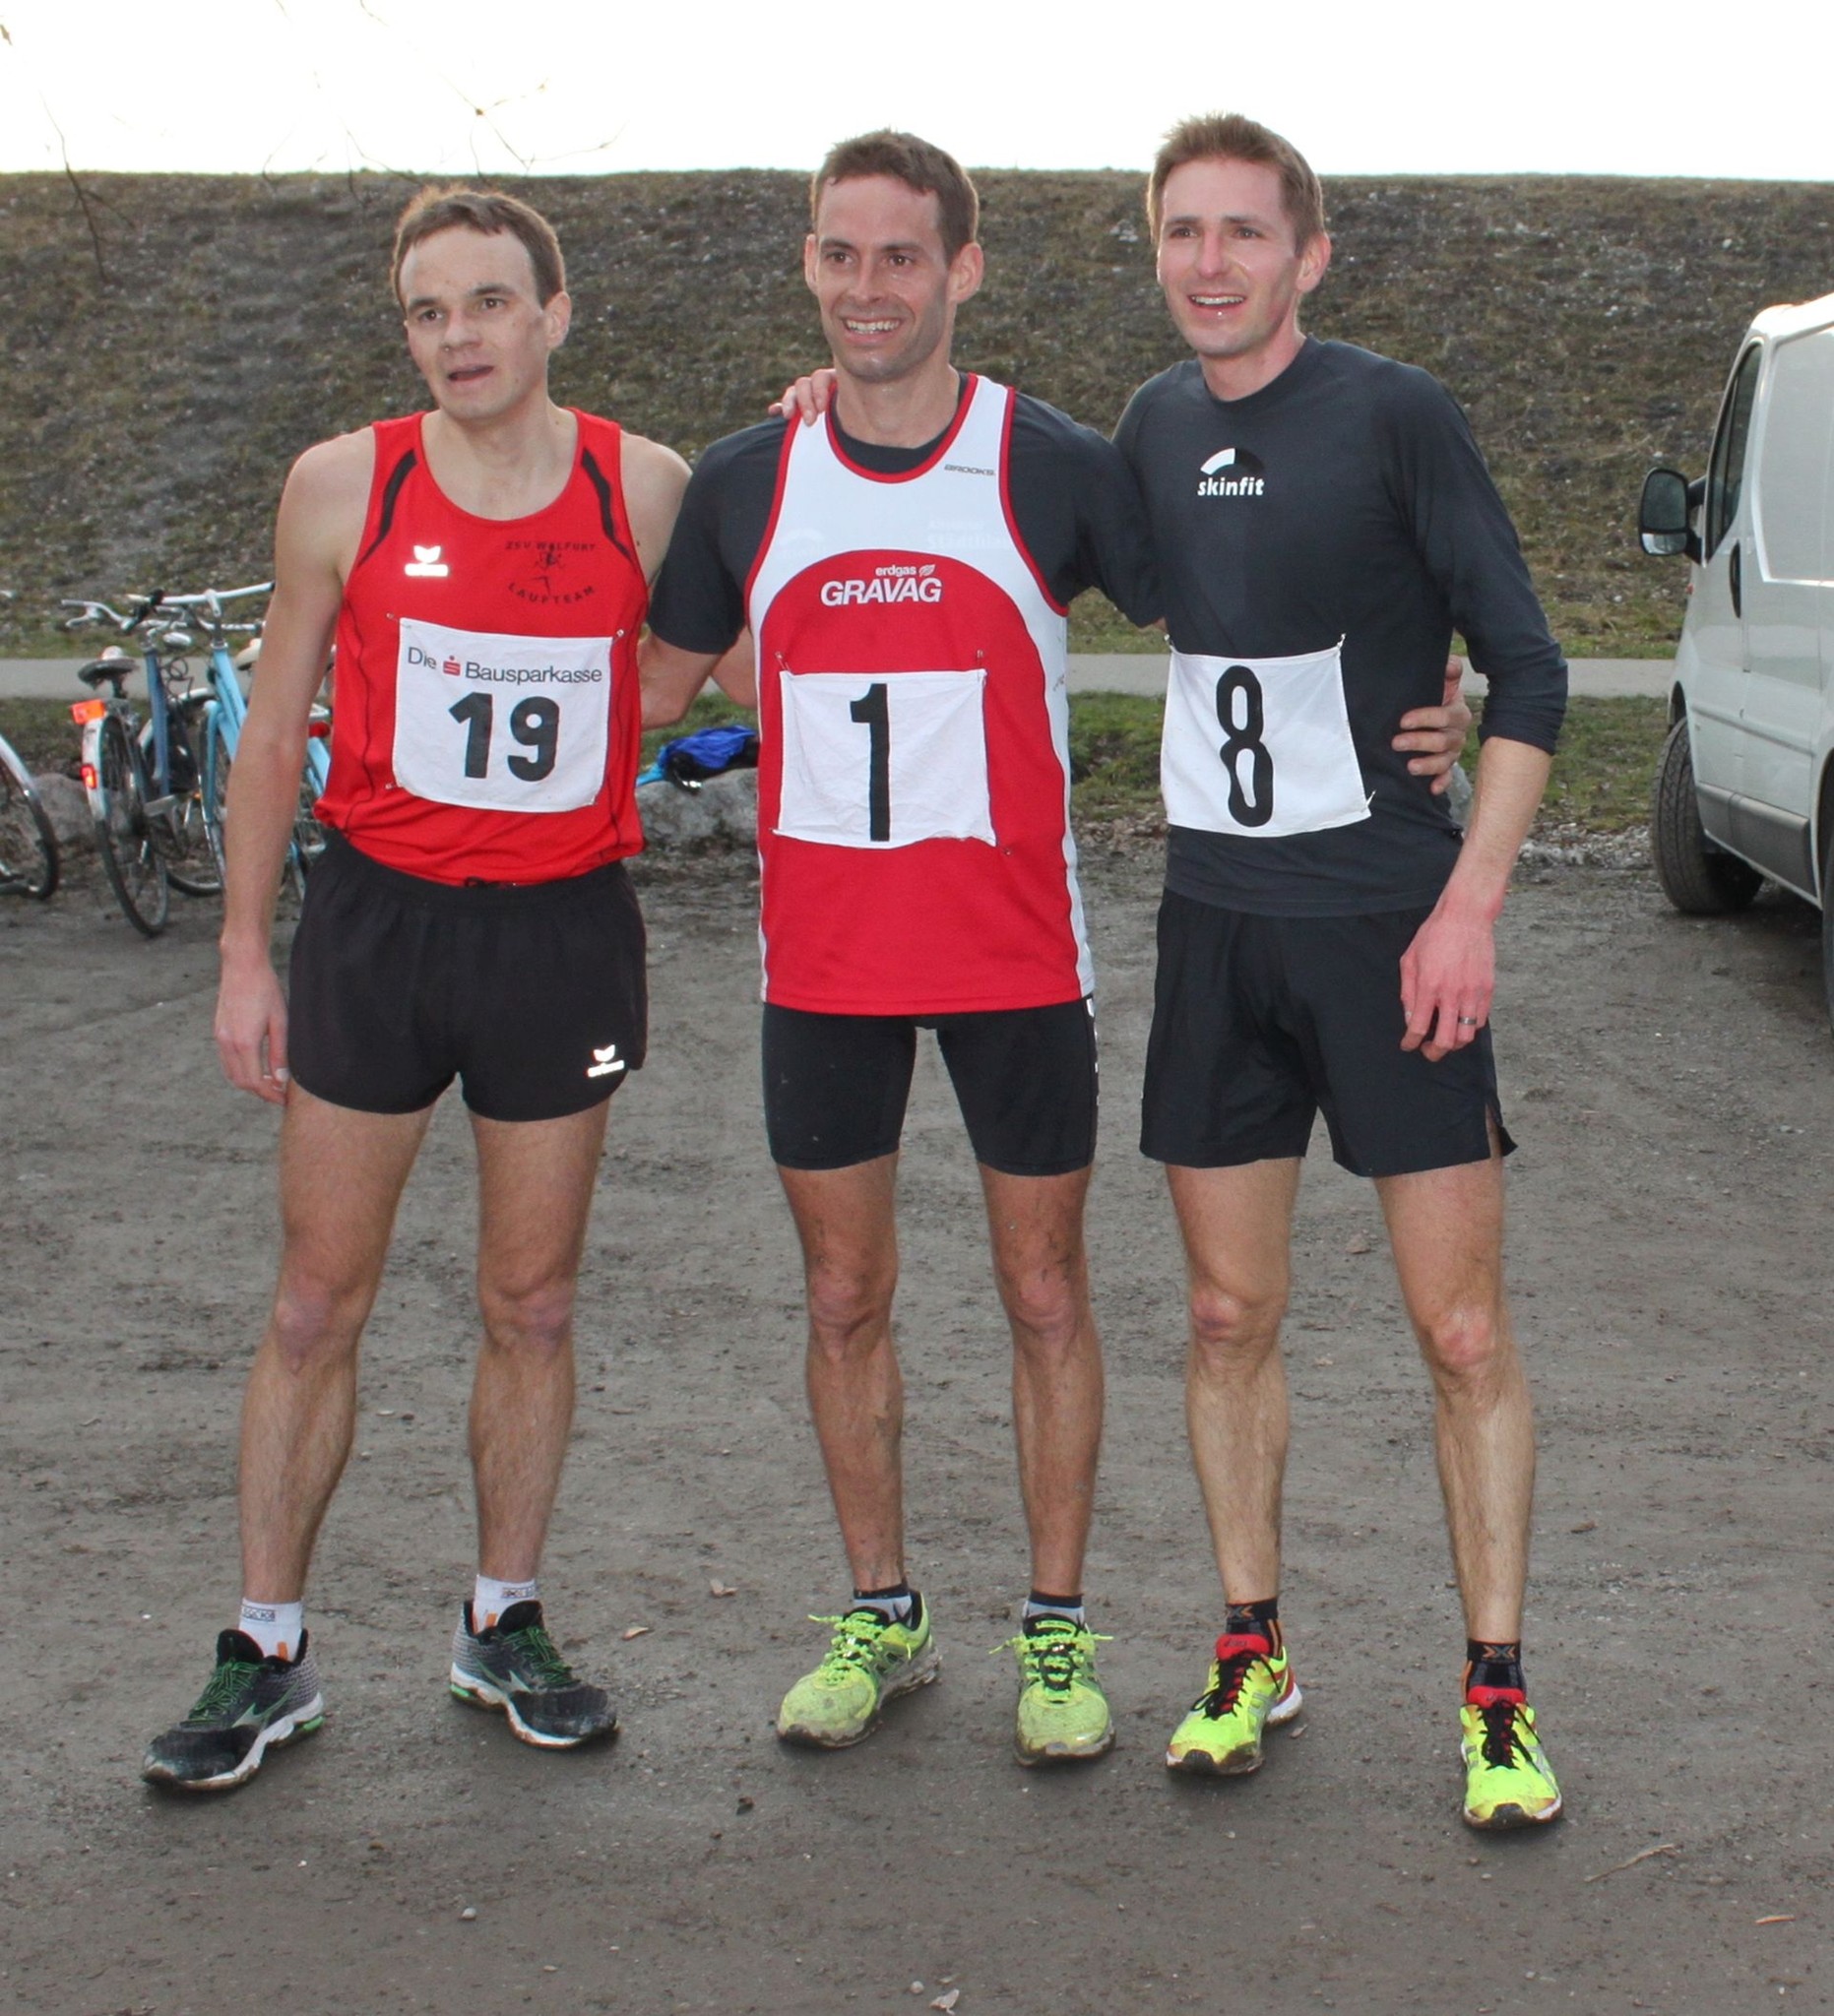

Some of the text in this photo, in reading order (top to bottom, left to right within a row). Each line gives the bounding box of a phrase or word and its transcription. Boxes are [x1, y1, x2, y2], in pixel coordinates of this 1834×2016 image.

[1197, 476, 1265, 496] skinfit
[875, 564, 917, 578] erdgas
[820, 577, 943, 606] GRAVAG
[407, 647, 602, 686] Die Bausparkasse
[448, 691, 560, 783] 19
[1216, 665, 1274, 828] 8
[850, 683, 891, 843] 1
